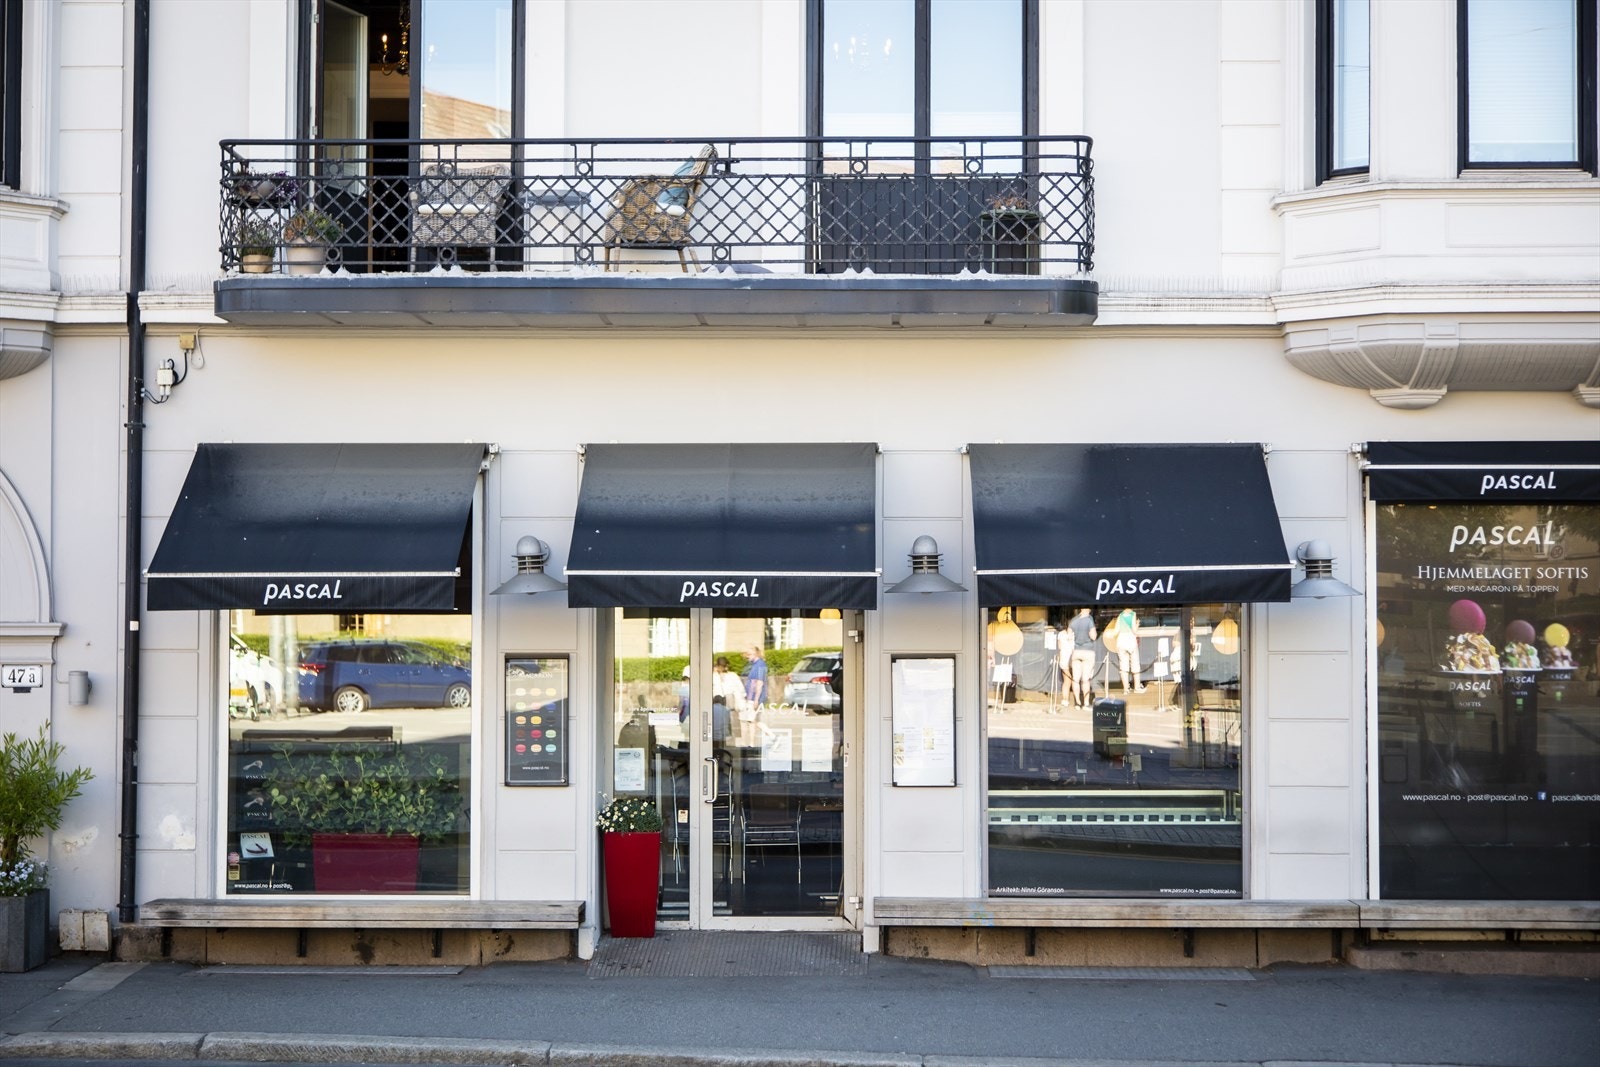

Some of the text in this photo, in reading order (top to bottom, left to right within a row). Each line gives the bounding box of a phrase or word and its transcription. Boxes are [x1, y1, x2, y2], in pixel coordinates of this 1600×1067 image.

[1536, 566, 1589, 580] SOFTIS
[1446, 583, 1559, 593] MED MACARON PÅ TOPPEN
[8, 669, 26, 683] 47
[1402, 793, 1461, 803] www.pascal.no
[1467, 793, 1529, 803] post@pascal.no
